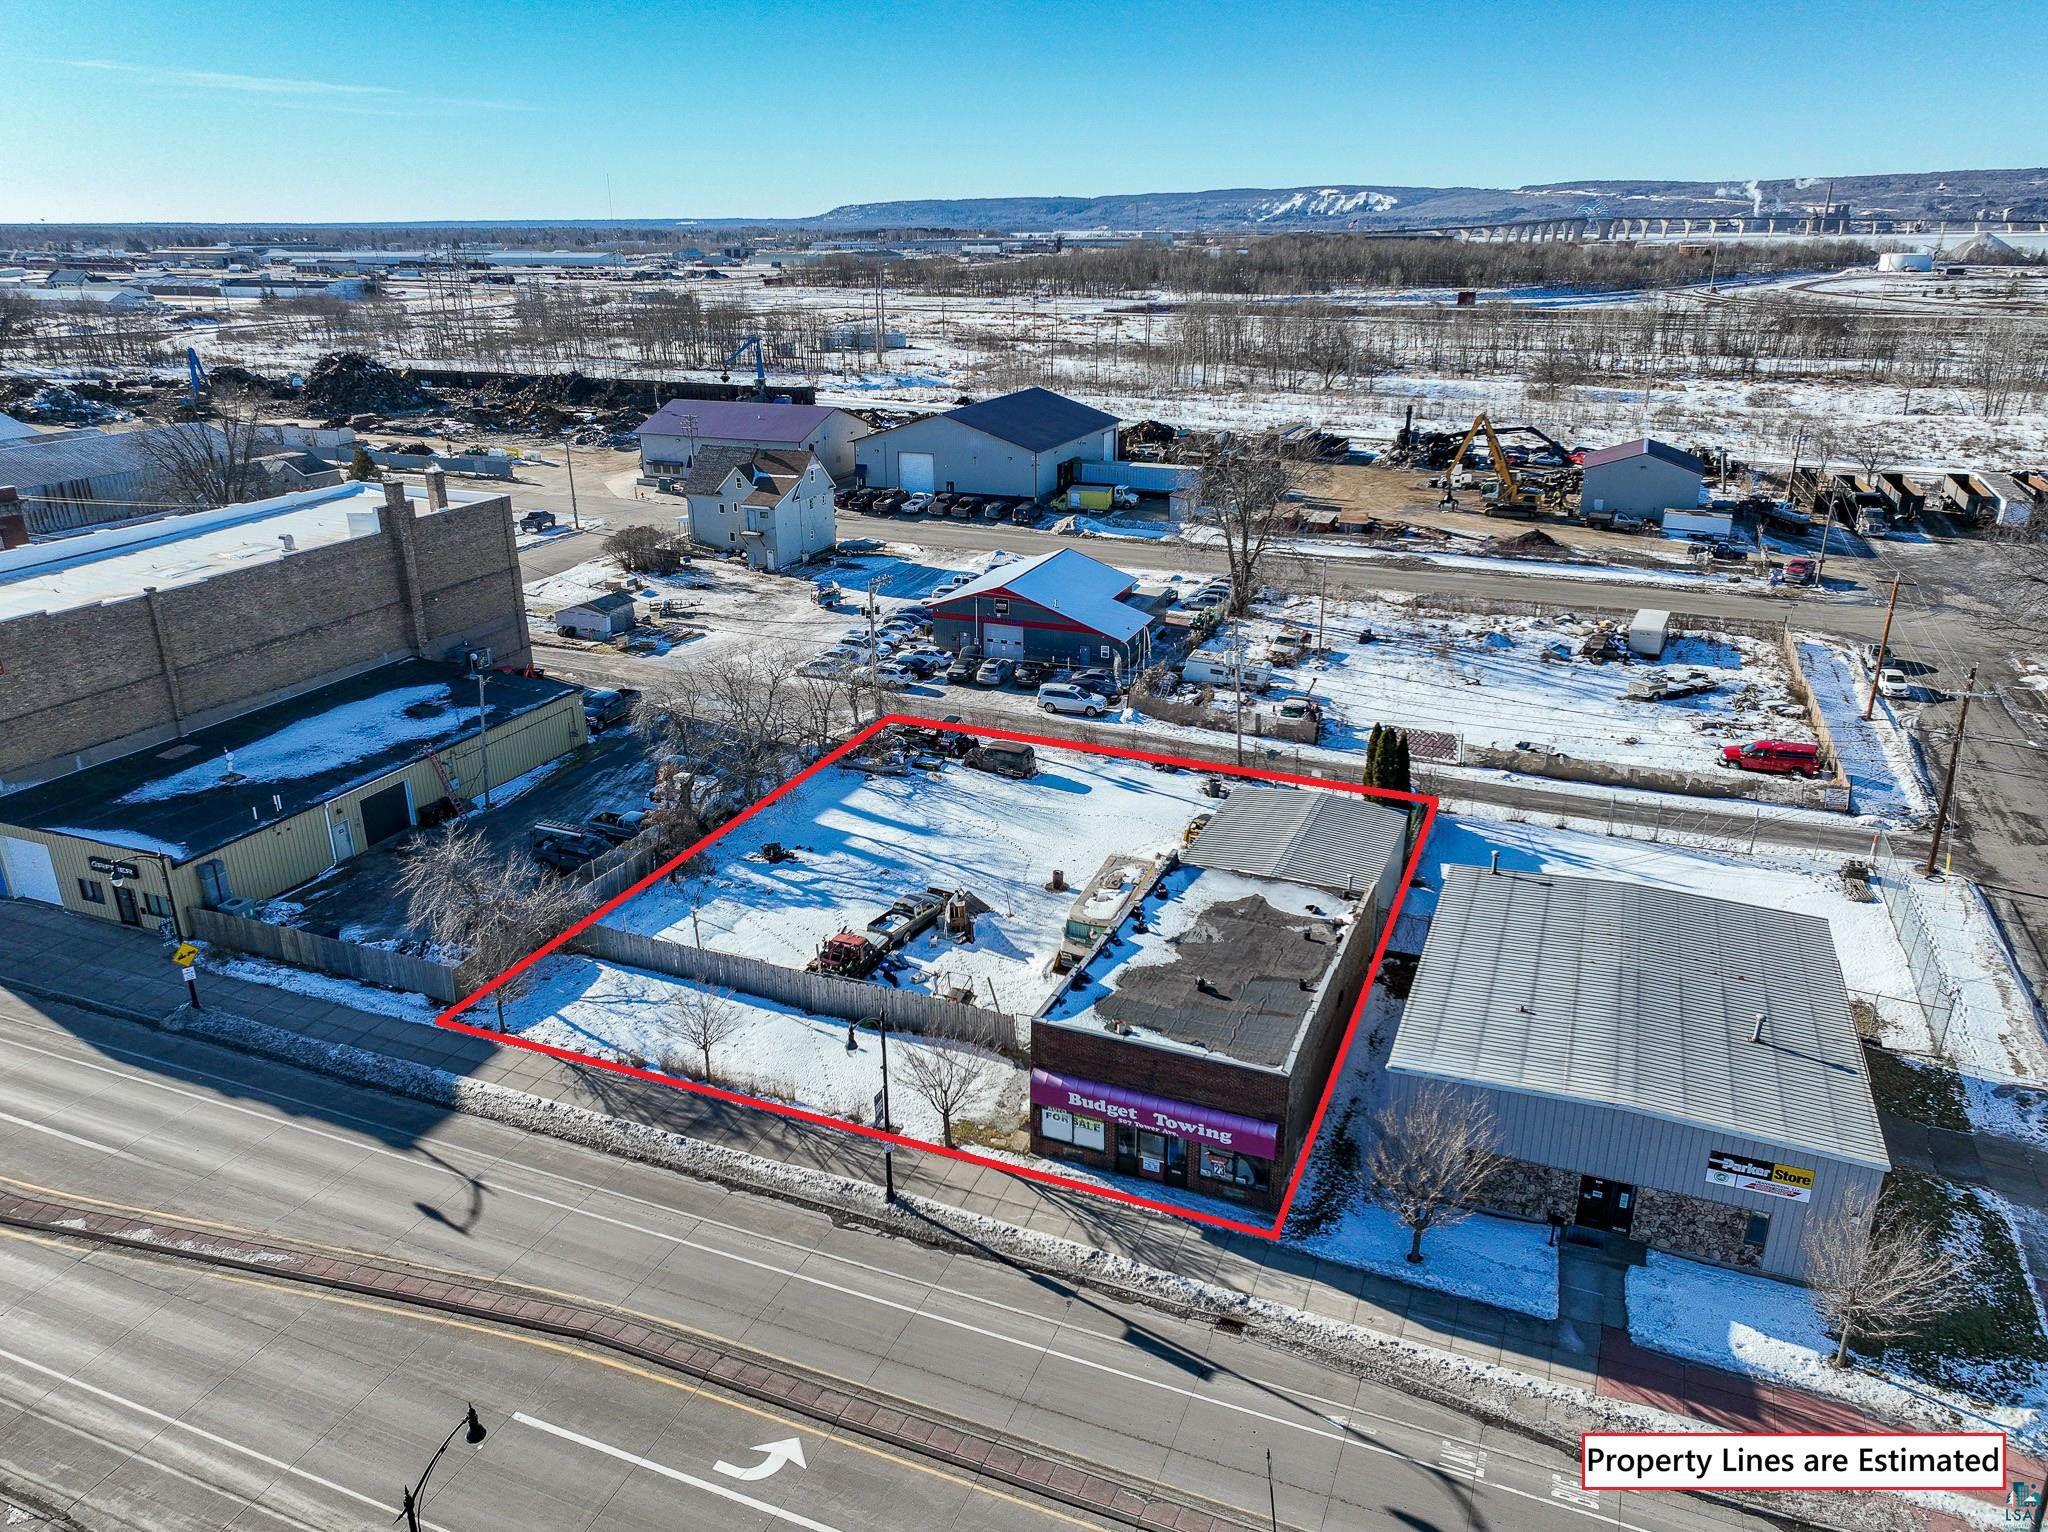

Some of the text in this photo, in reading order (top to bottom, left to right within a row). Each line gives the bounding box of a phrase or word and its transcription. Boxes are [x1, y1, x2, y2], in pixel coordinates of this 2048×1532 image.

[1045, 1112, 1069, 1124] FOR
[1072, 1119, 1101, 1132] SALE
[1068, 1092, 1232, 1144] Budget Towing
[1134, 1122, 1160, 1132] Tower
[1723, 1158, 1771, 1178] Parker
[1774, 1169, 1811, 1186] Store
